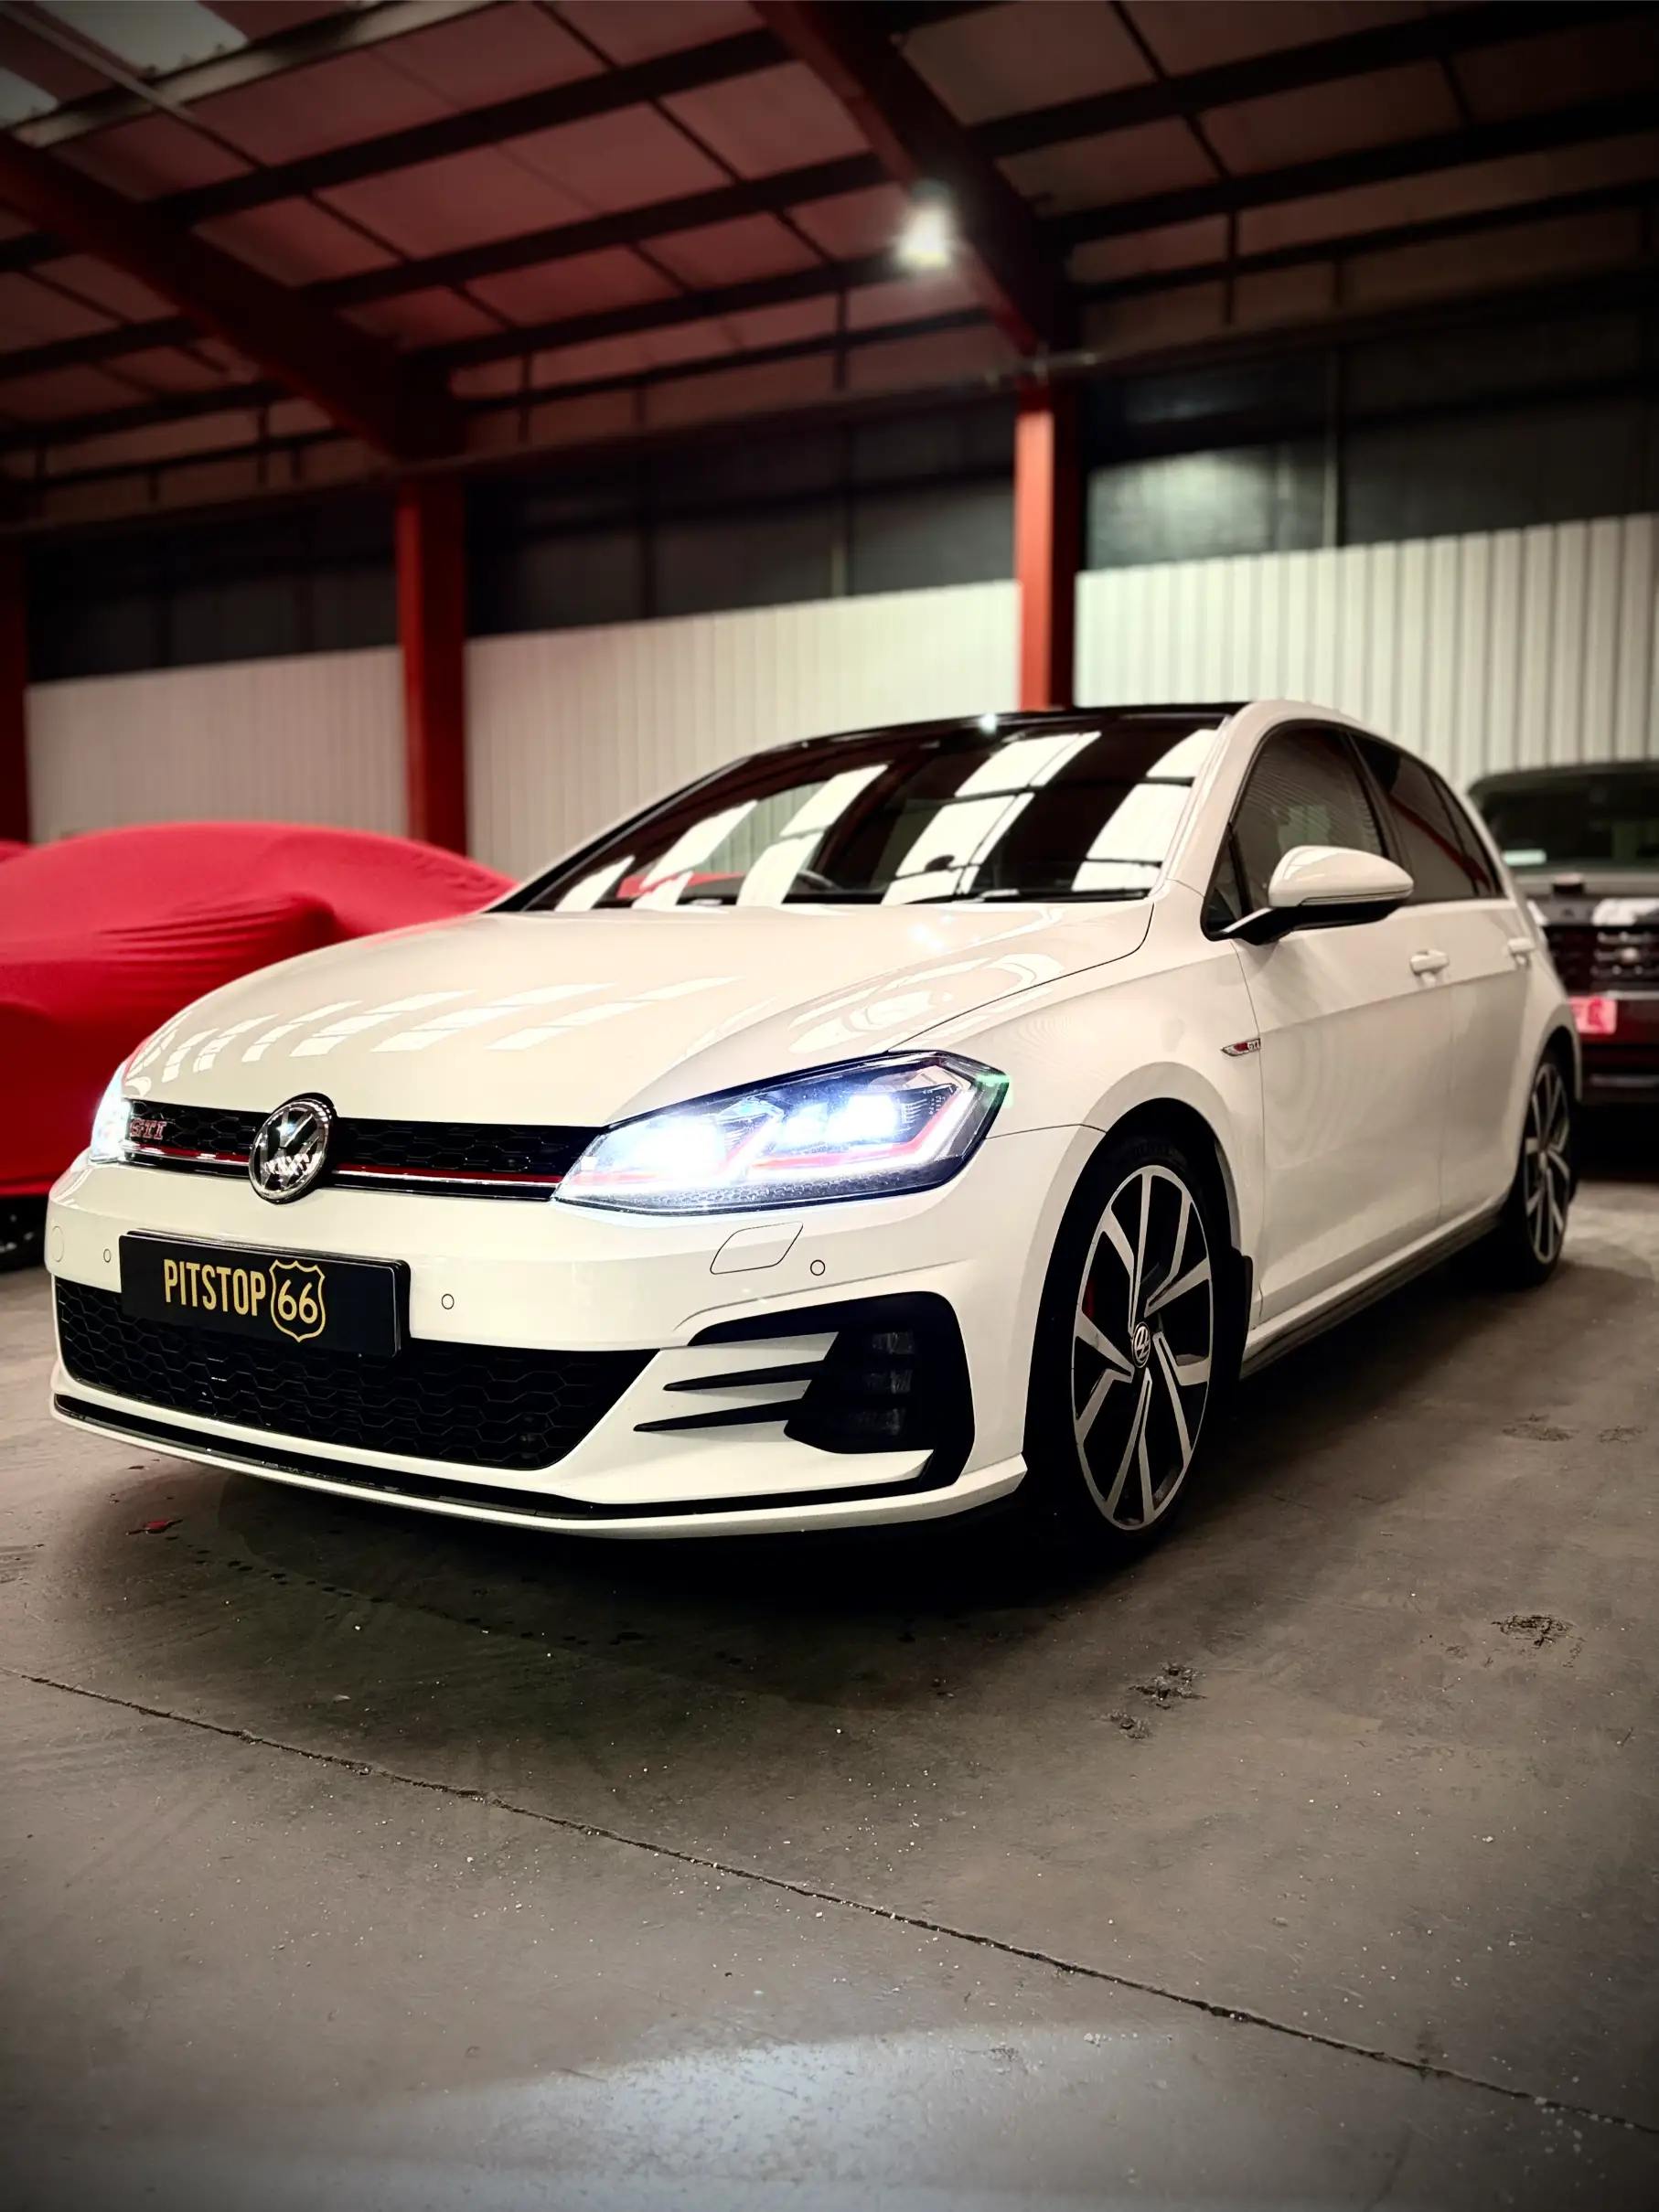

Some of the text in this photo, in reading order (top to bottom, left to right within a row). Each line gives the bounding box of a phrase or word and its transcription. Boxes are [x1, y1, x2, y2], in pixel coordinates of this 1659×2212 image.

[130, 1117, 167, 1140] GTI
[164, 1259, 318, 1324] PITSTOP 66
